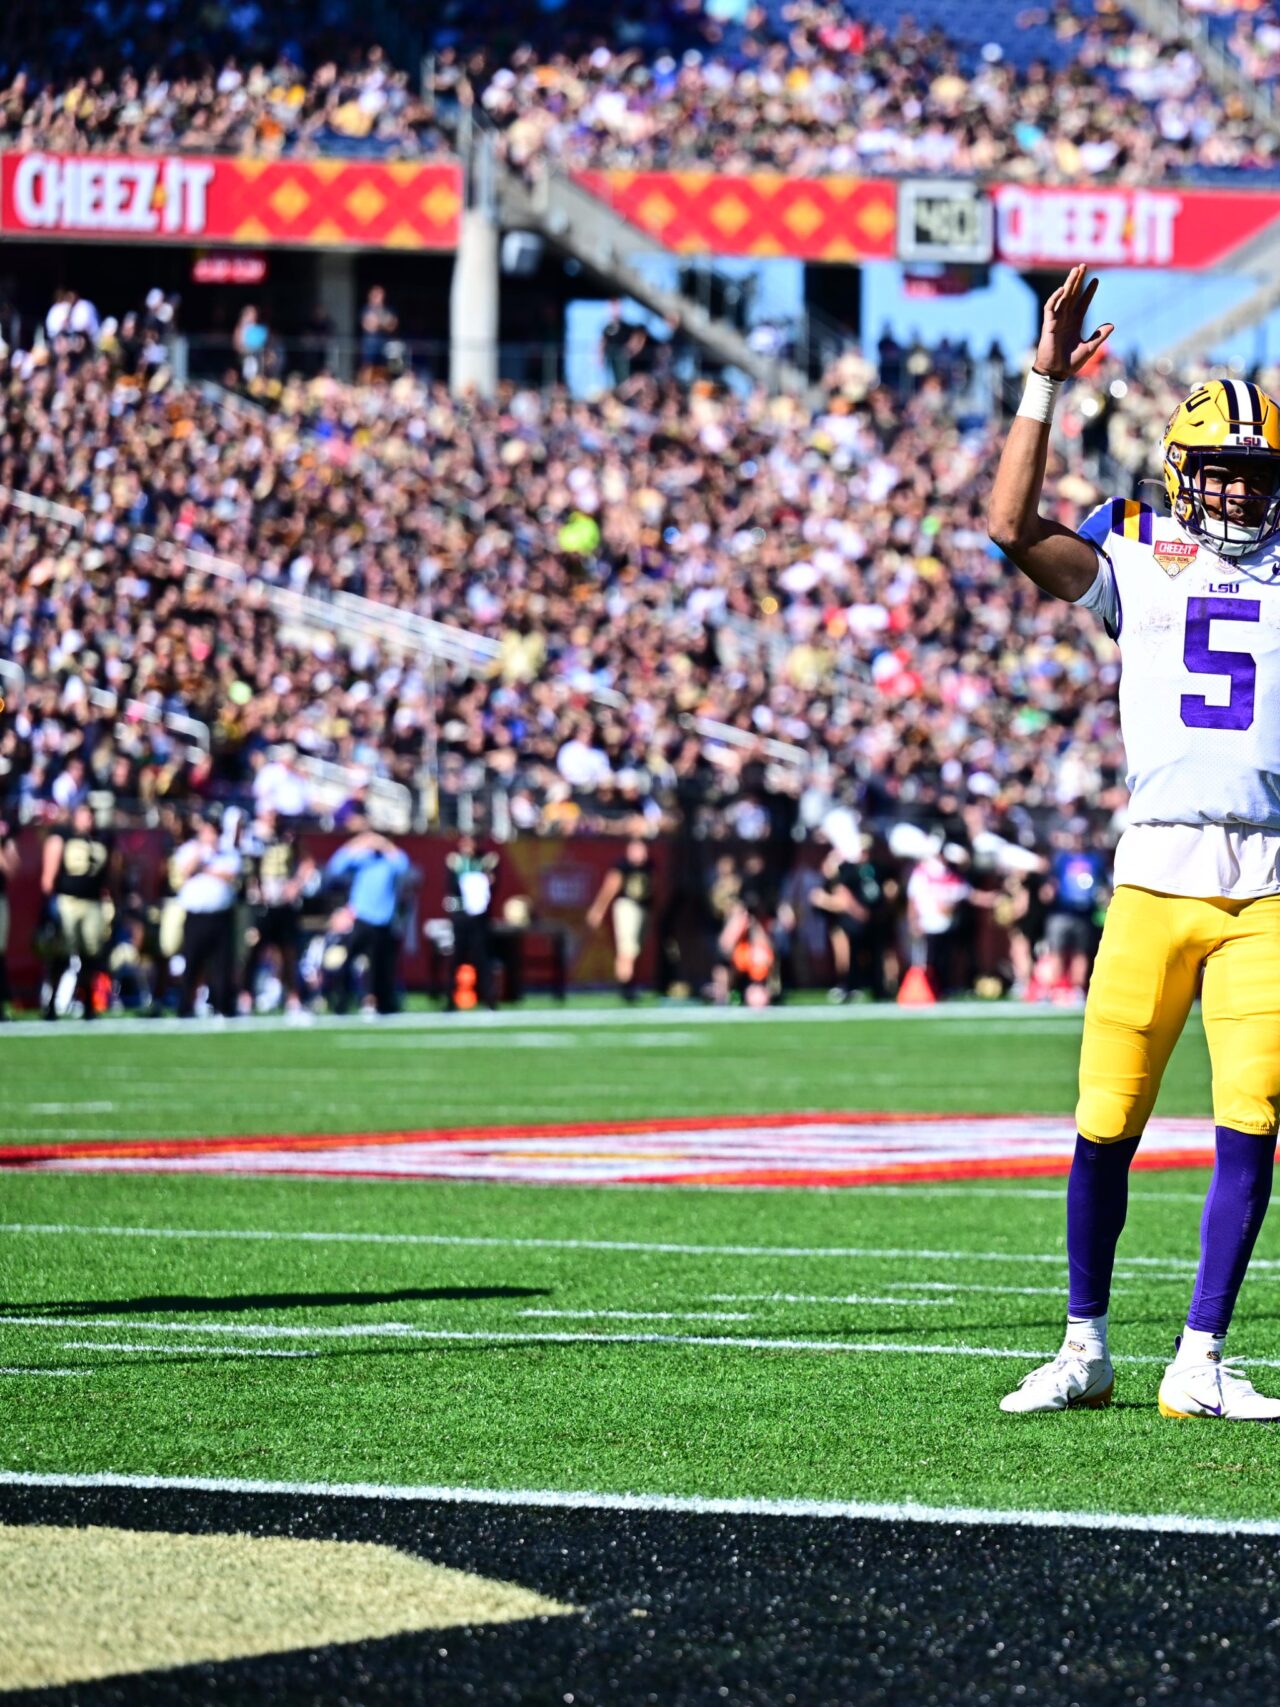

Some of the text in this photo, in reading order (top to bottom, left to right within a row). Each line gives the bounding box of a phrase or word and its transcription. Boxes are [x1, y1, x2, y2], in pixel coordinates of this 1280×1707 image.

[1236, 436, 1261, 446] LSU
[1209, 583, 1240, 594] LSU
[1180, 597, 1261, 731] 5
